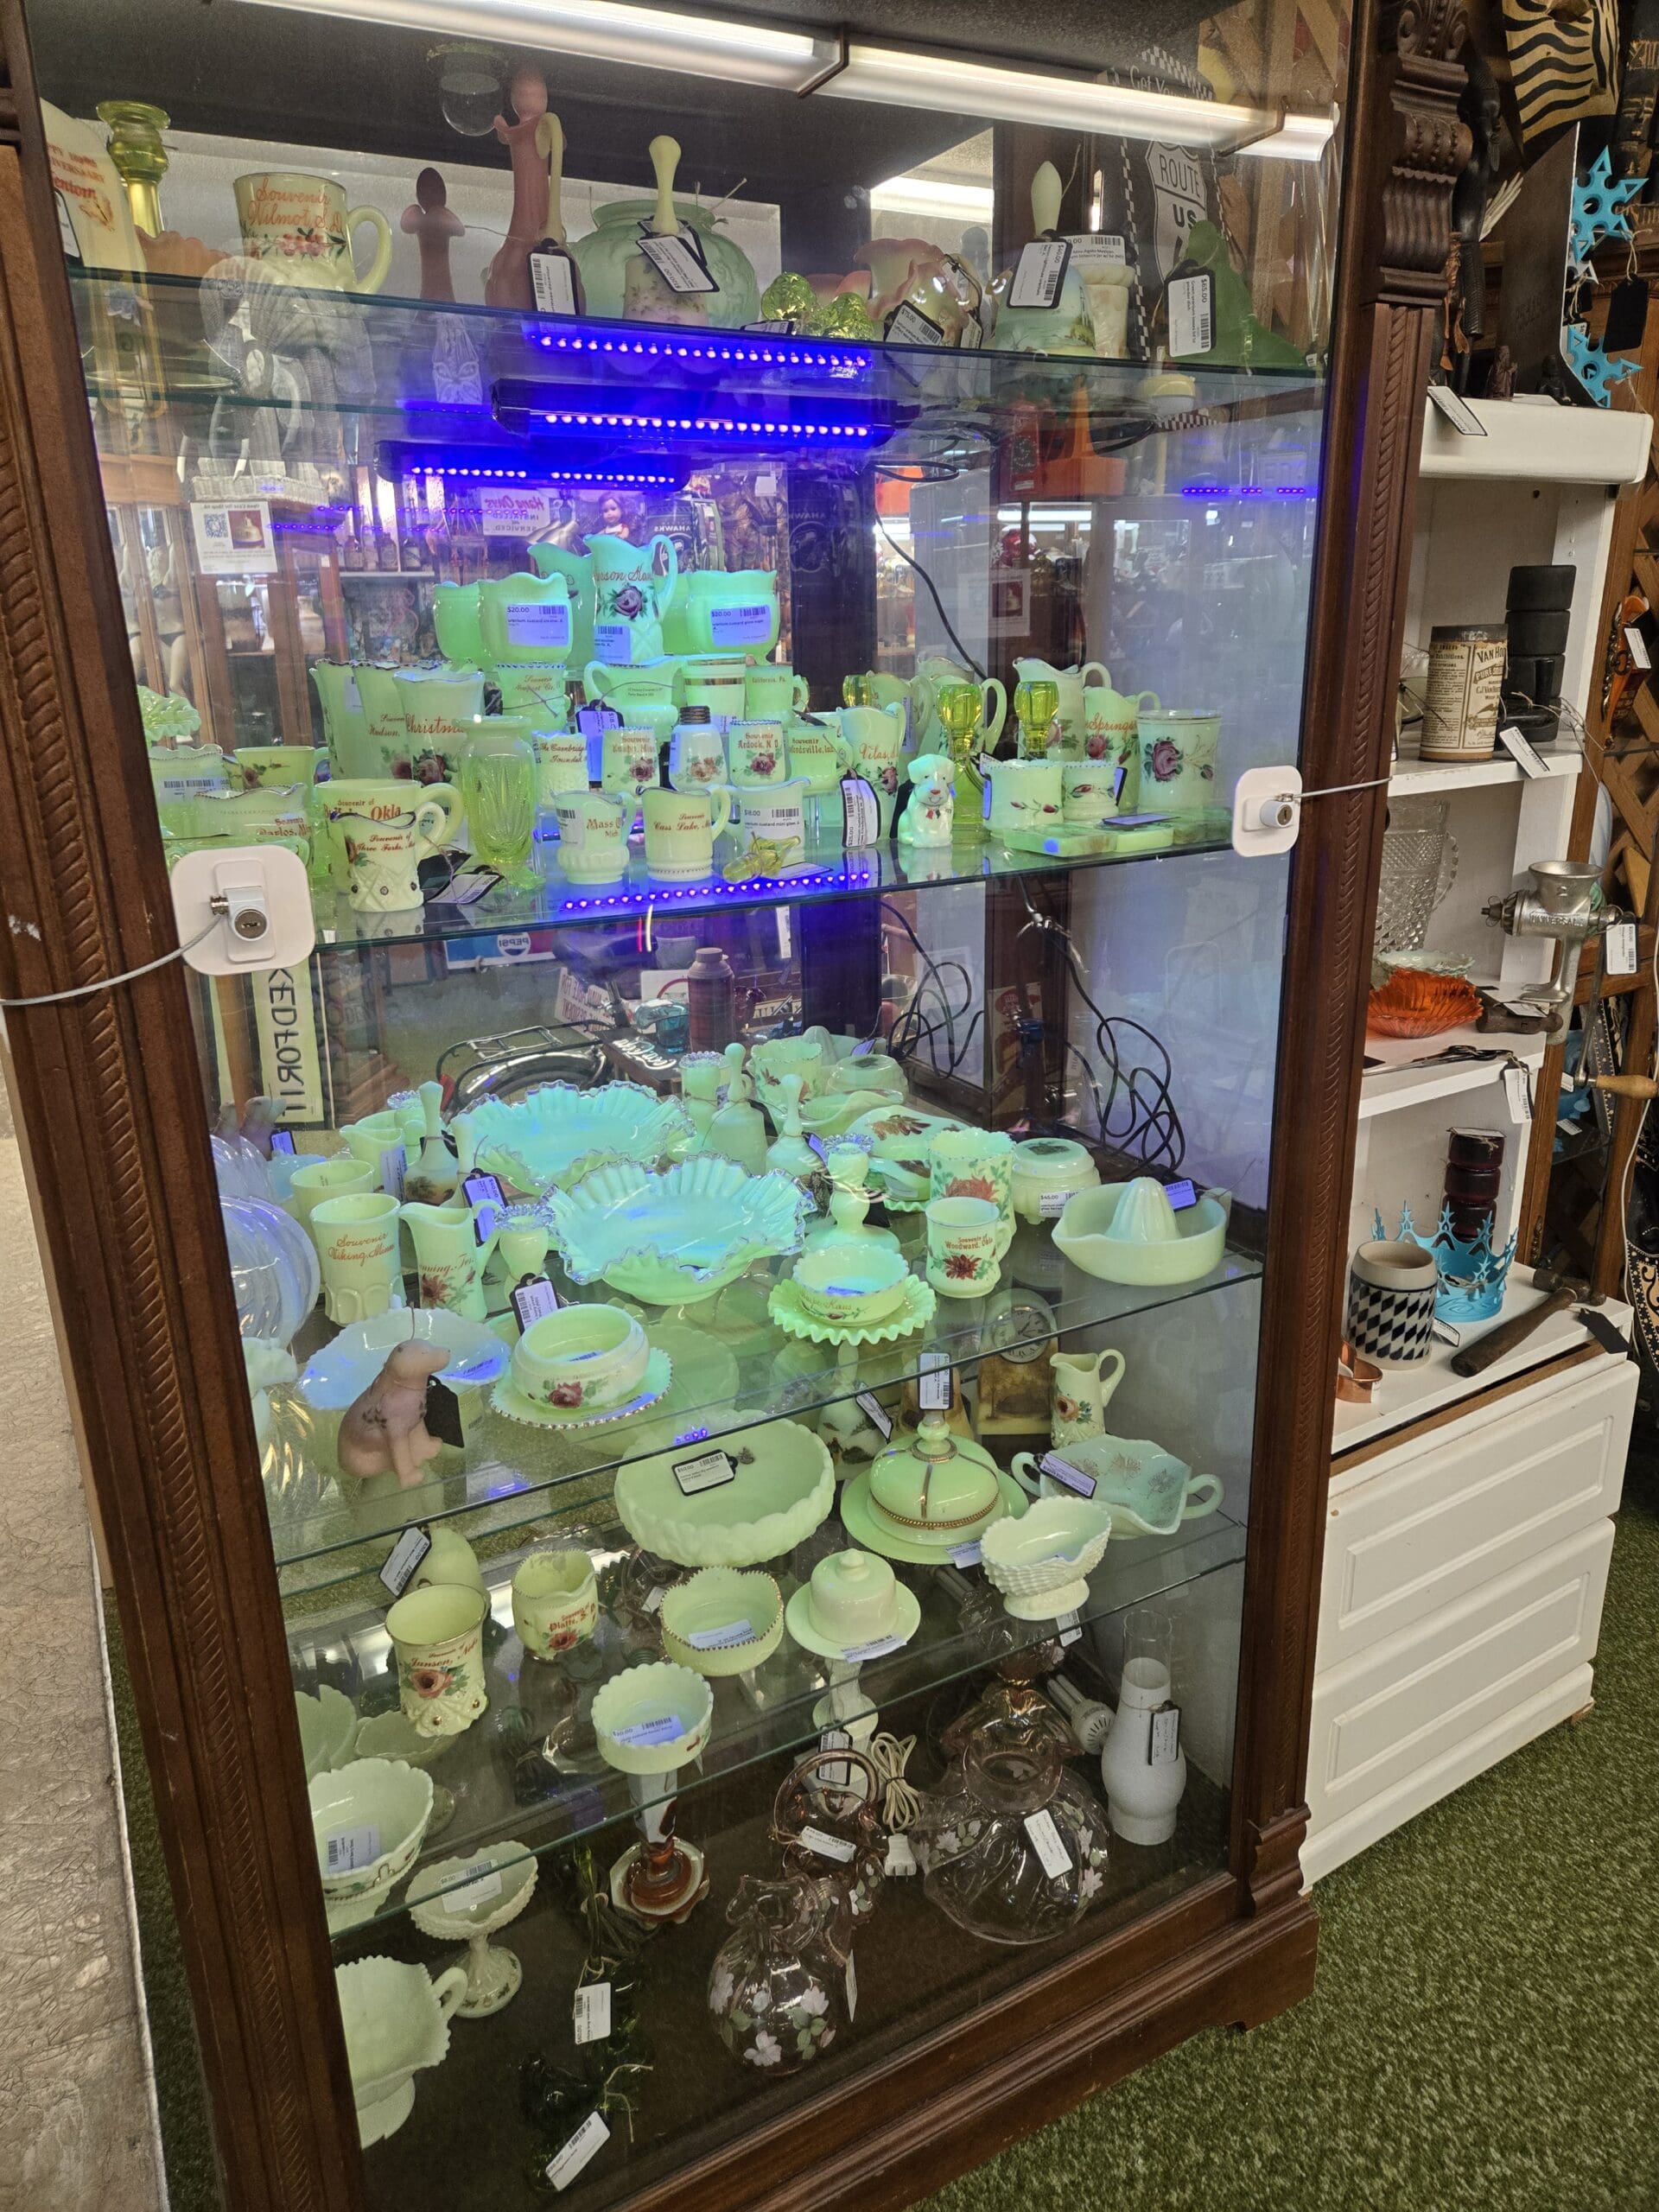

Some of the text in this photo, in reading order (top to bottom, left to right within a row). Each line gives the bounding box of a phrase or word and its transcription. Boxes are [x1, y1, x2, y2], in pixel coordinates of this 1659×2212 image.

[1160, 154, 1200, 199] ROUTE
[1173, 203, 1197, 230] US
[1477, 650, 1494, 664] VAN
[1476, 666, 1493, 680] PURE
[587, 819, 613, 830] Mass
[336, 1234, 387, 1248] Souvenir
